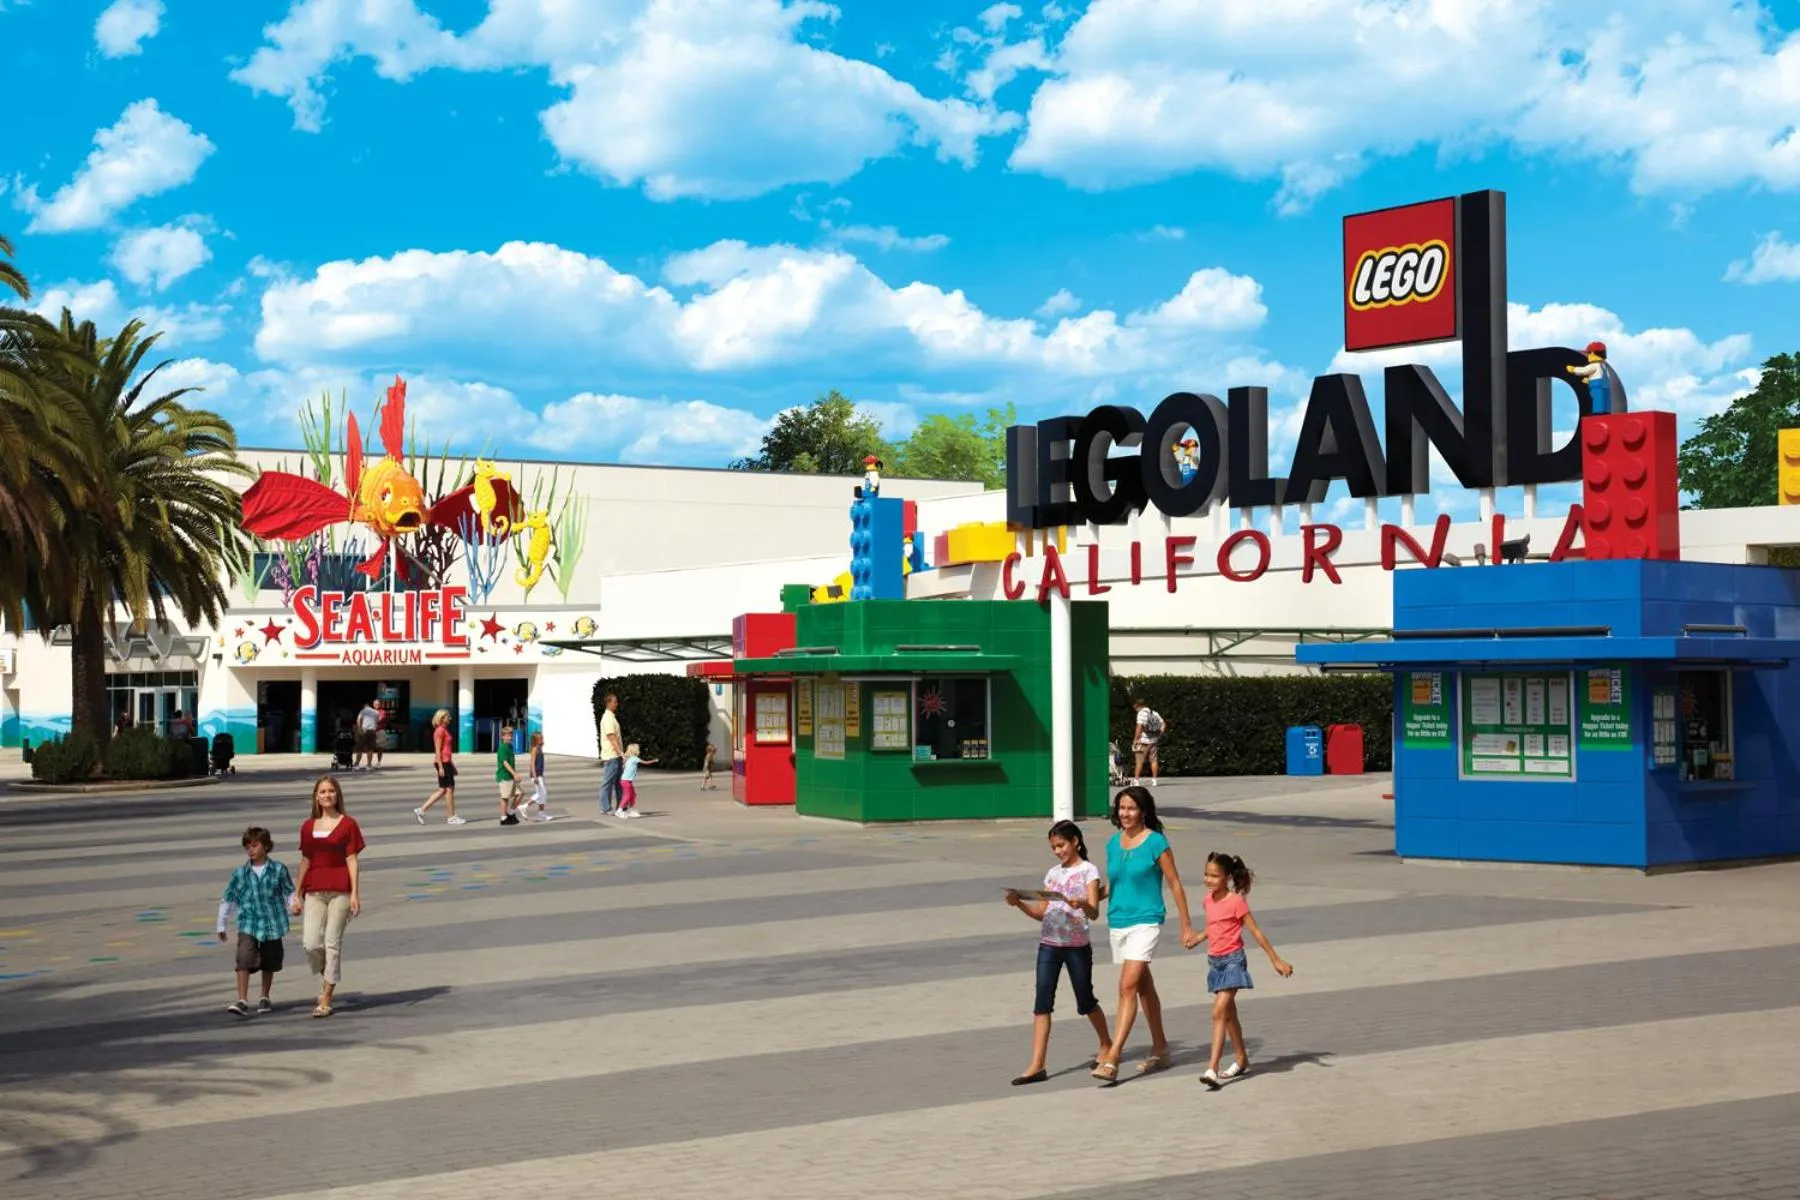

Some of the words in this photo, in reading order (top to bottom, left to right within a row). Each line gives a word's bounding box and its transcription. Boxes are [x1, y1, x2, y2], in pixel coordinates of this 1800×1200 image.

[1351, 243, 1449, 307] LEGO
[1007, 190, 1627, 530] LEGOLAND
[1003, 503, 1586, 605] CALIFORNIA
[342, 650, 423, 665] AQUARIUM
